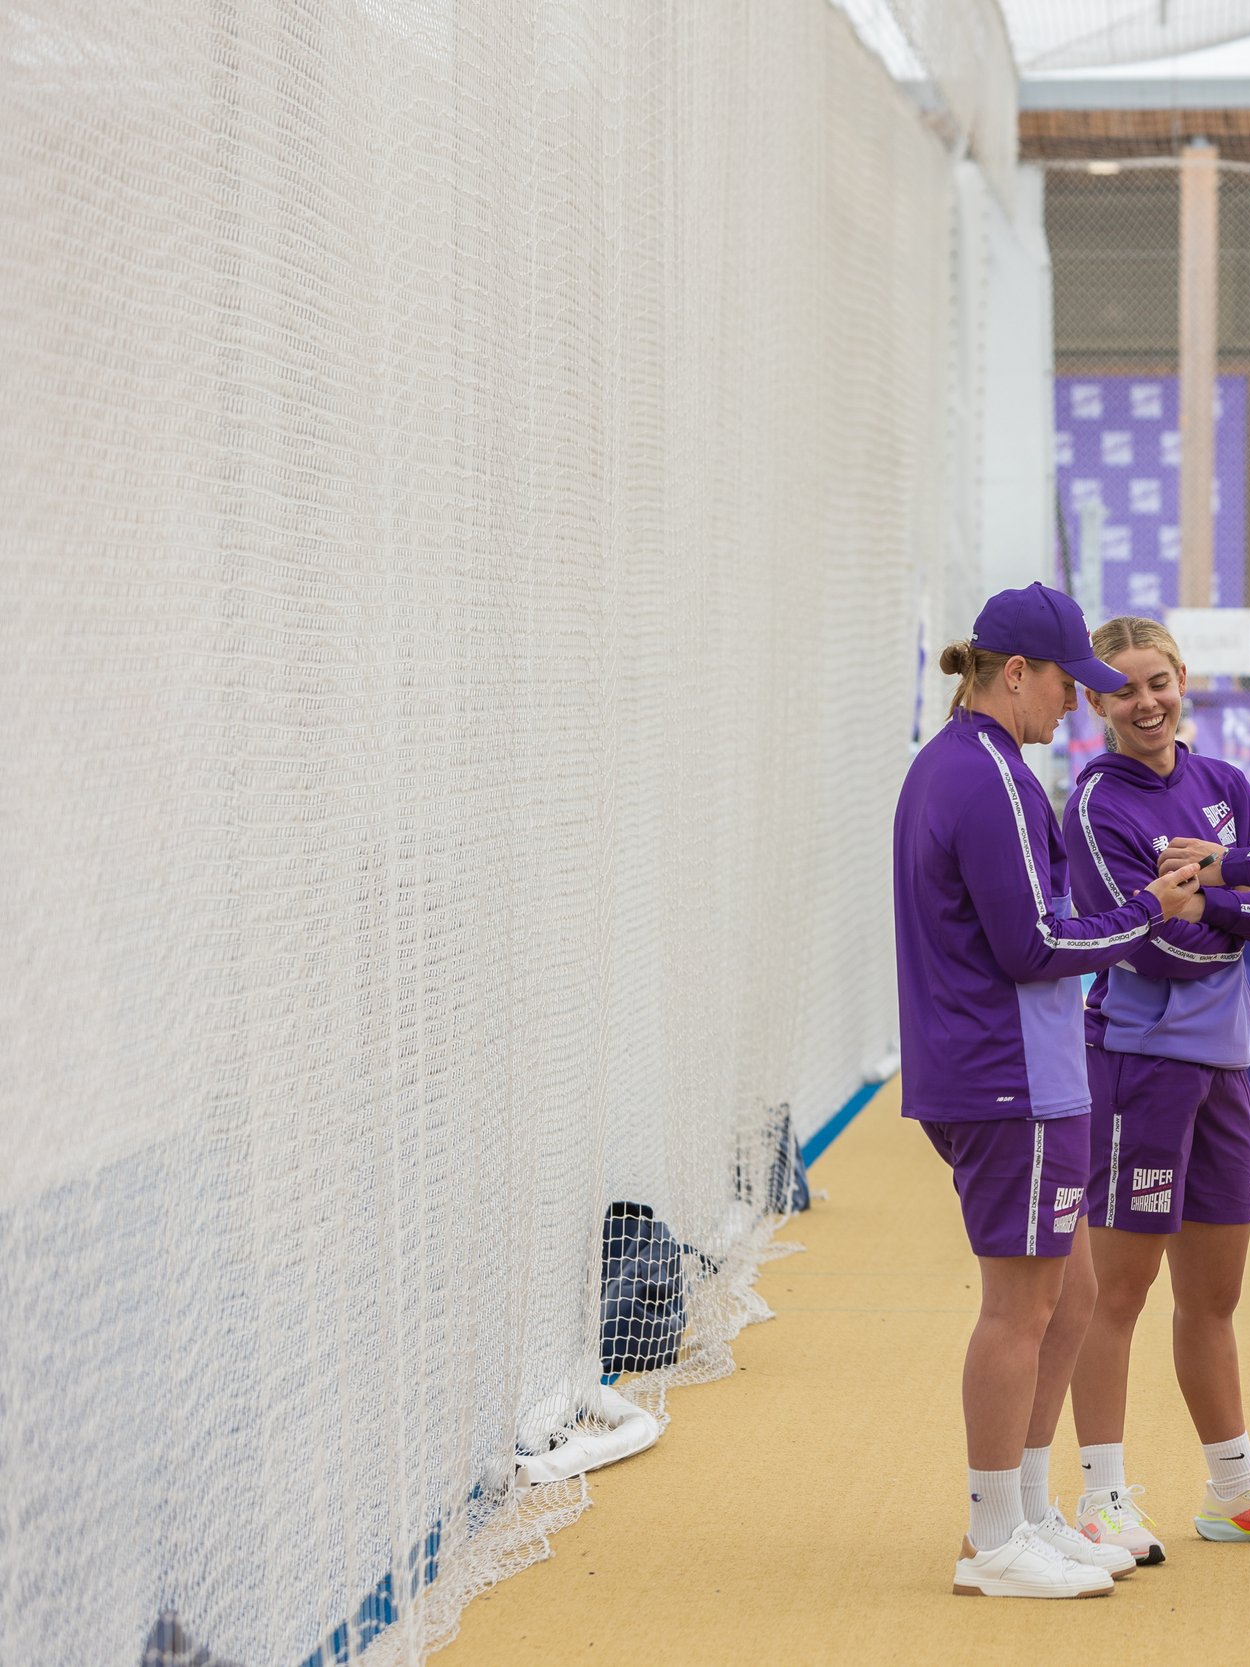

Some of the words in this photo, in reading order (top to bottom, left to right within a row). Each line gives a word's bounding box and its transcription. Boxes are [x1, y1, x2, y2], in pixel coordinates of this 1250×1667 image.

[1202, 801, 1231, 828] SUPER
[1133, 1168, 1173, 1190] SUPER
[1131, 1189, 1172, 1213] CHARGERS
